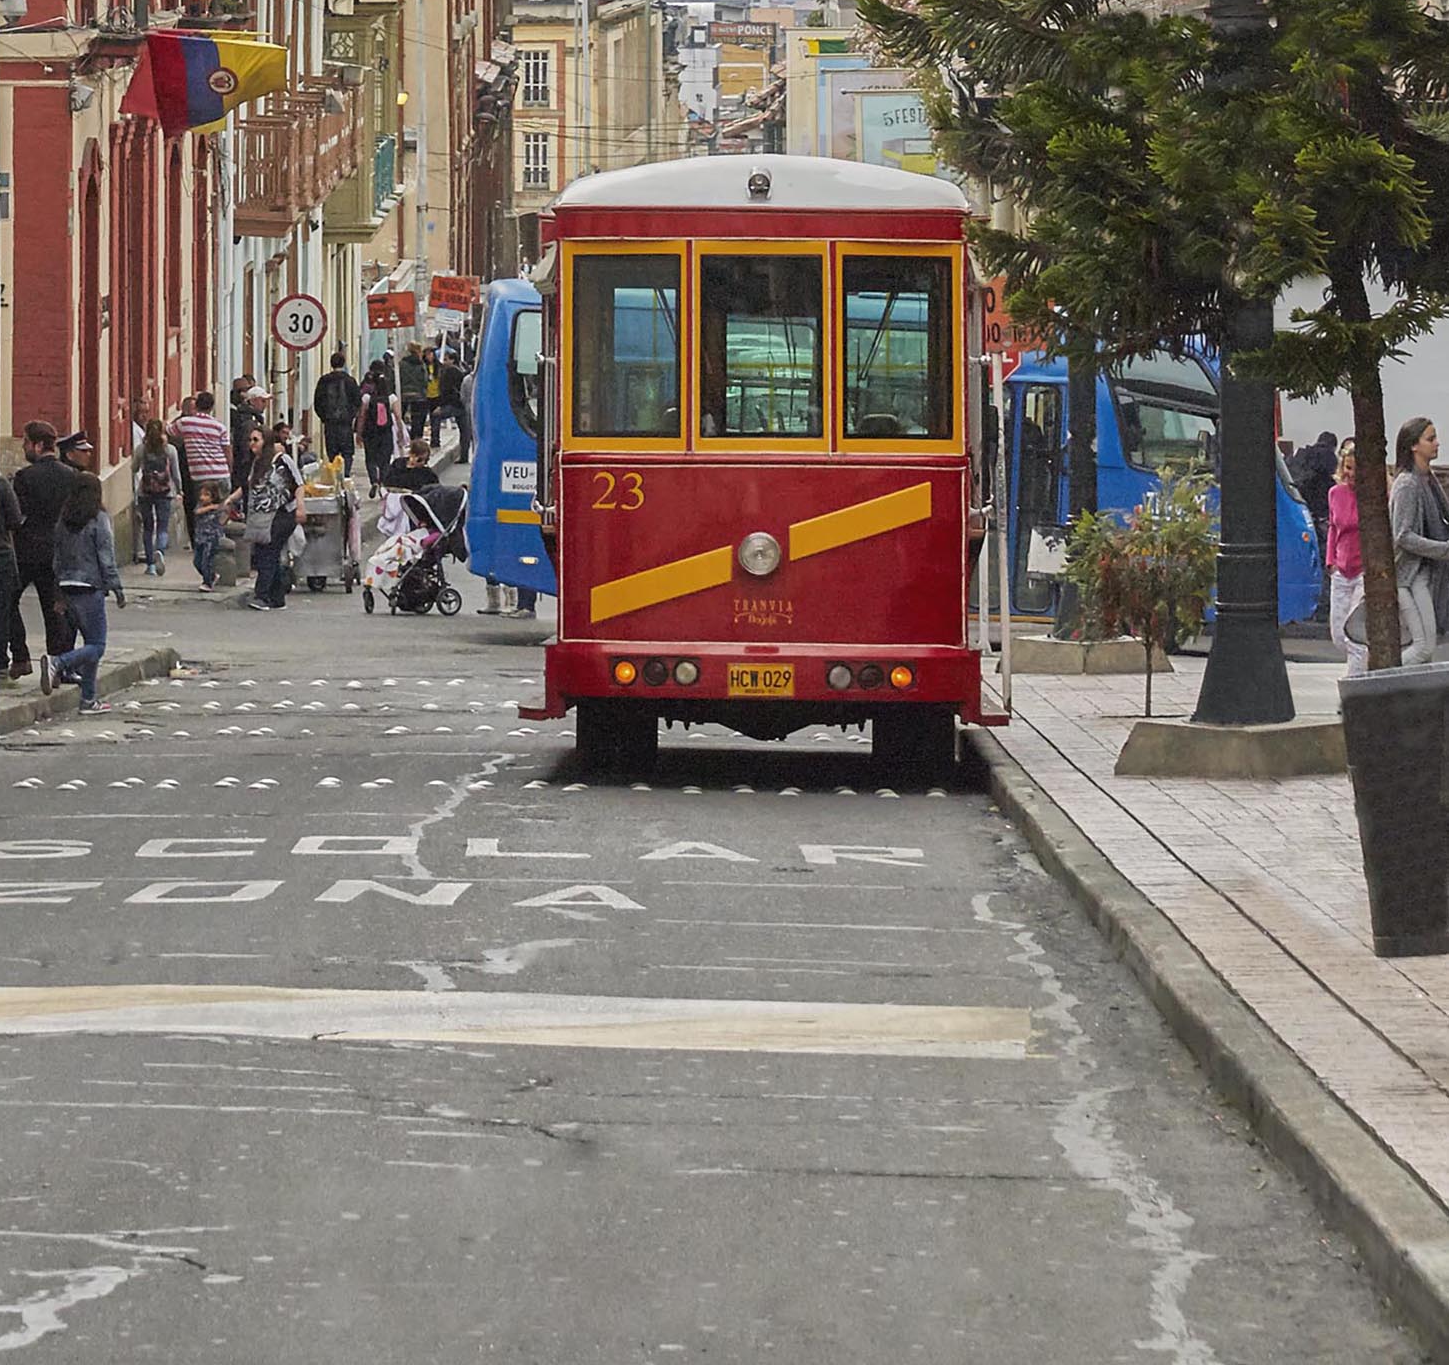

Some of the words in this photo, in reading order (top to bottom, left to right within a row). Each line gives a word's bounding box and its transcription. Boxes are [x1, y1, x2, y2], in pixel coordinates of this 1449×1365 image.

[737, 25, 773, 35] PONCE
[288, 313, 313, 334] 30
[592, 471, 645, 511] 23
[763, 670, 792, 687] 029
